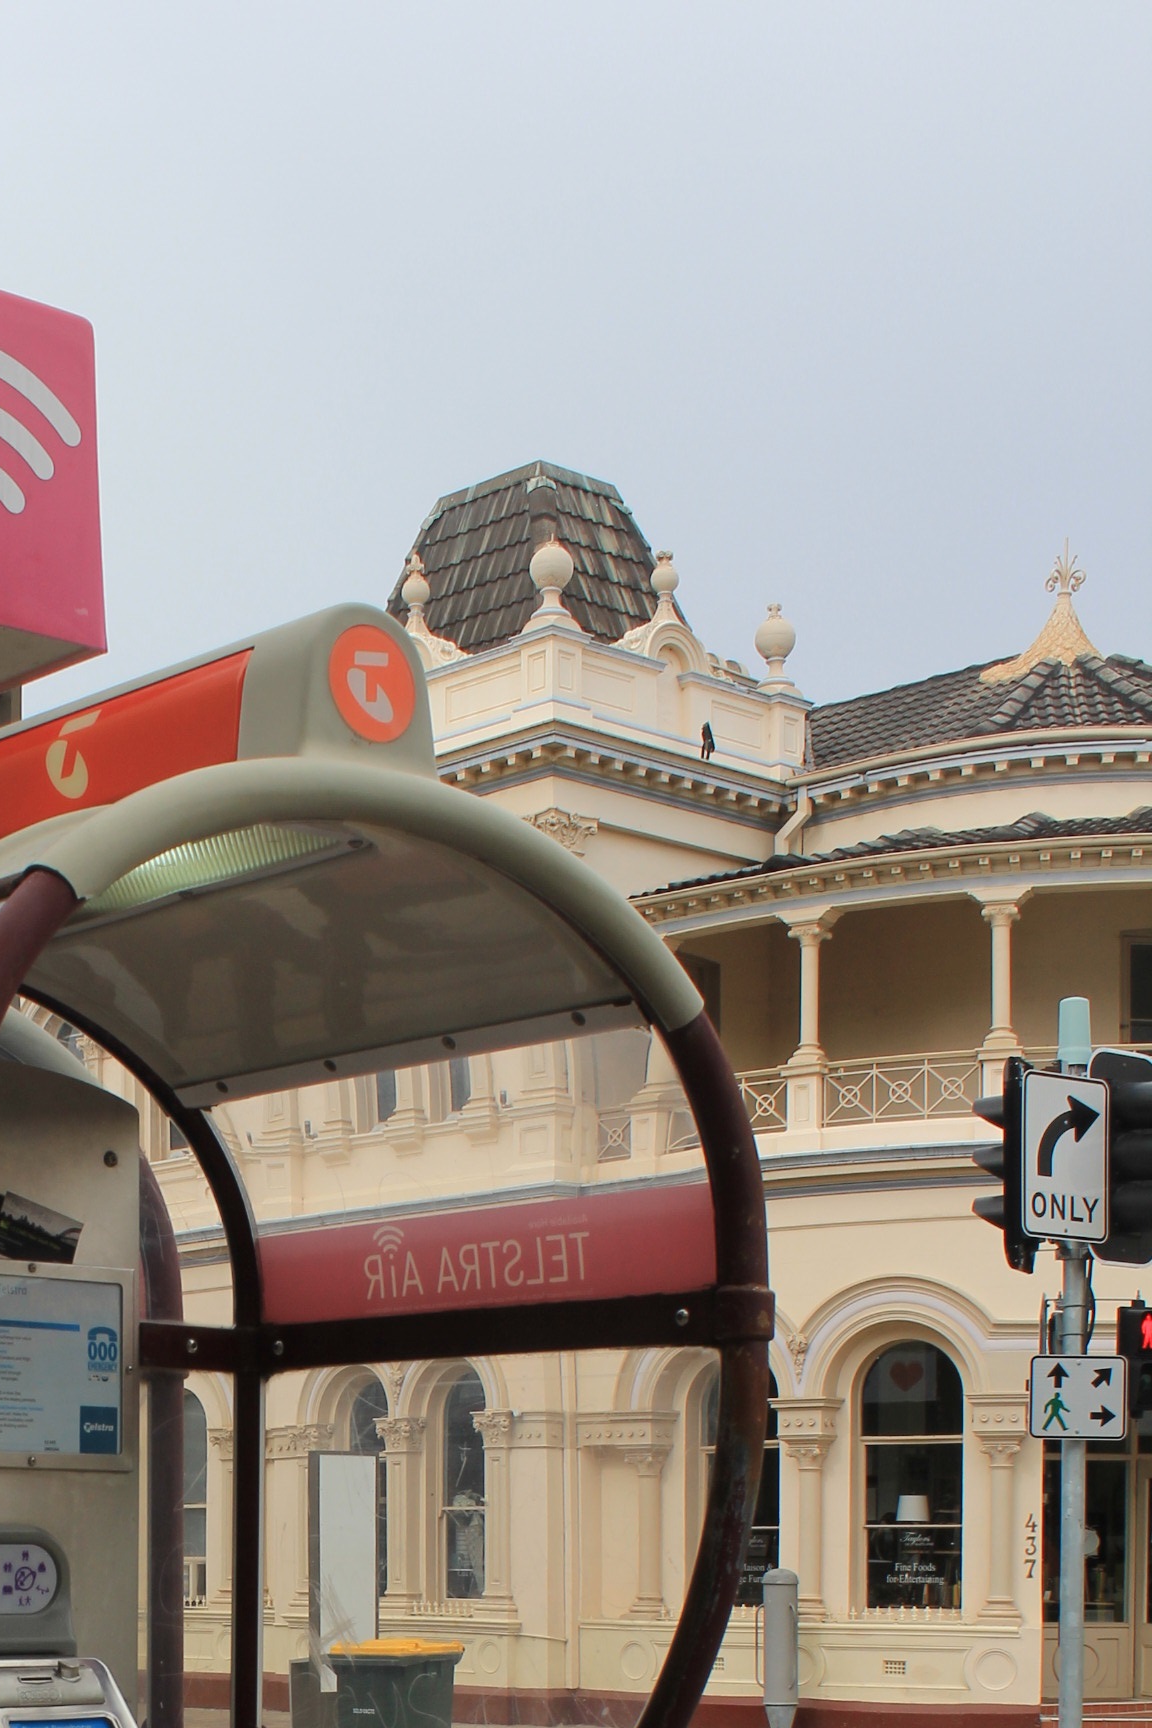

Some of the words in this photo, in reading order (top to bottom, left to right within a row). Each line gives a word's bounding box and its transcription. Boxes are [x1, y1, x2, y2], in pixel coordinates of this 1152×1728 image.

[1031, 1191, 1100, 1224] ONLY
[87, 1341, 118, 1362] 000
[83, 1421, 115, 1434] Telstra
[1023, 1512, 1038, 1580] 437
[894, 1562, 911, 1571] Fine
[913, 1562, 936, 1572] Foods
[886, 1574, 898, 1583] for
[899, 1573, 945, 1586] Entertaining
